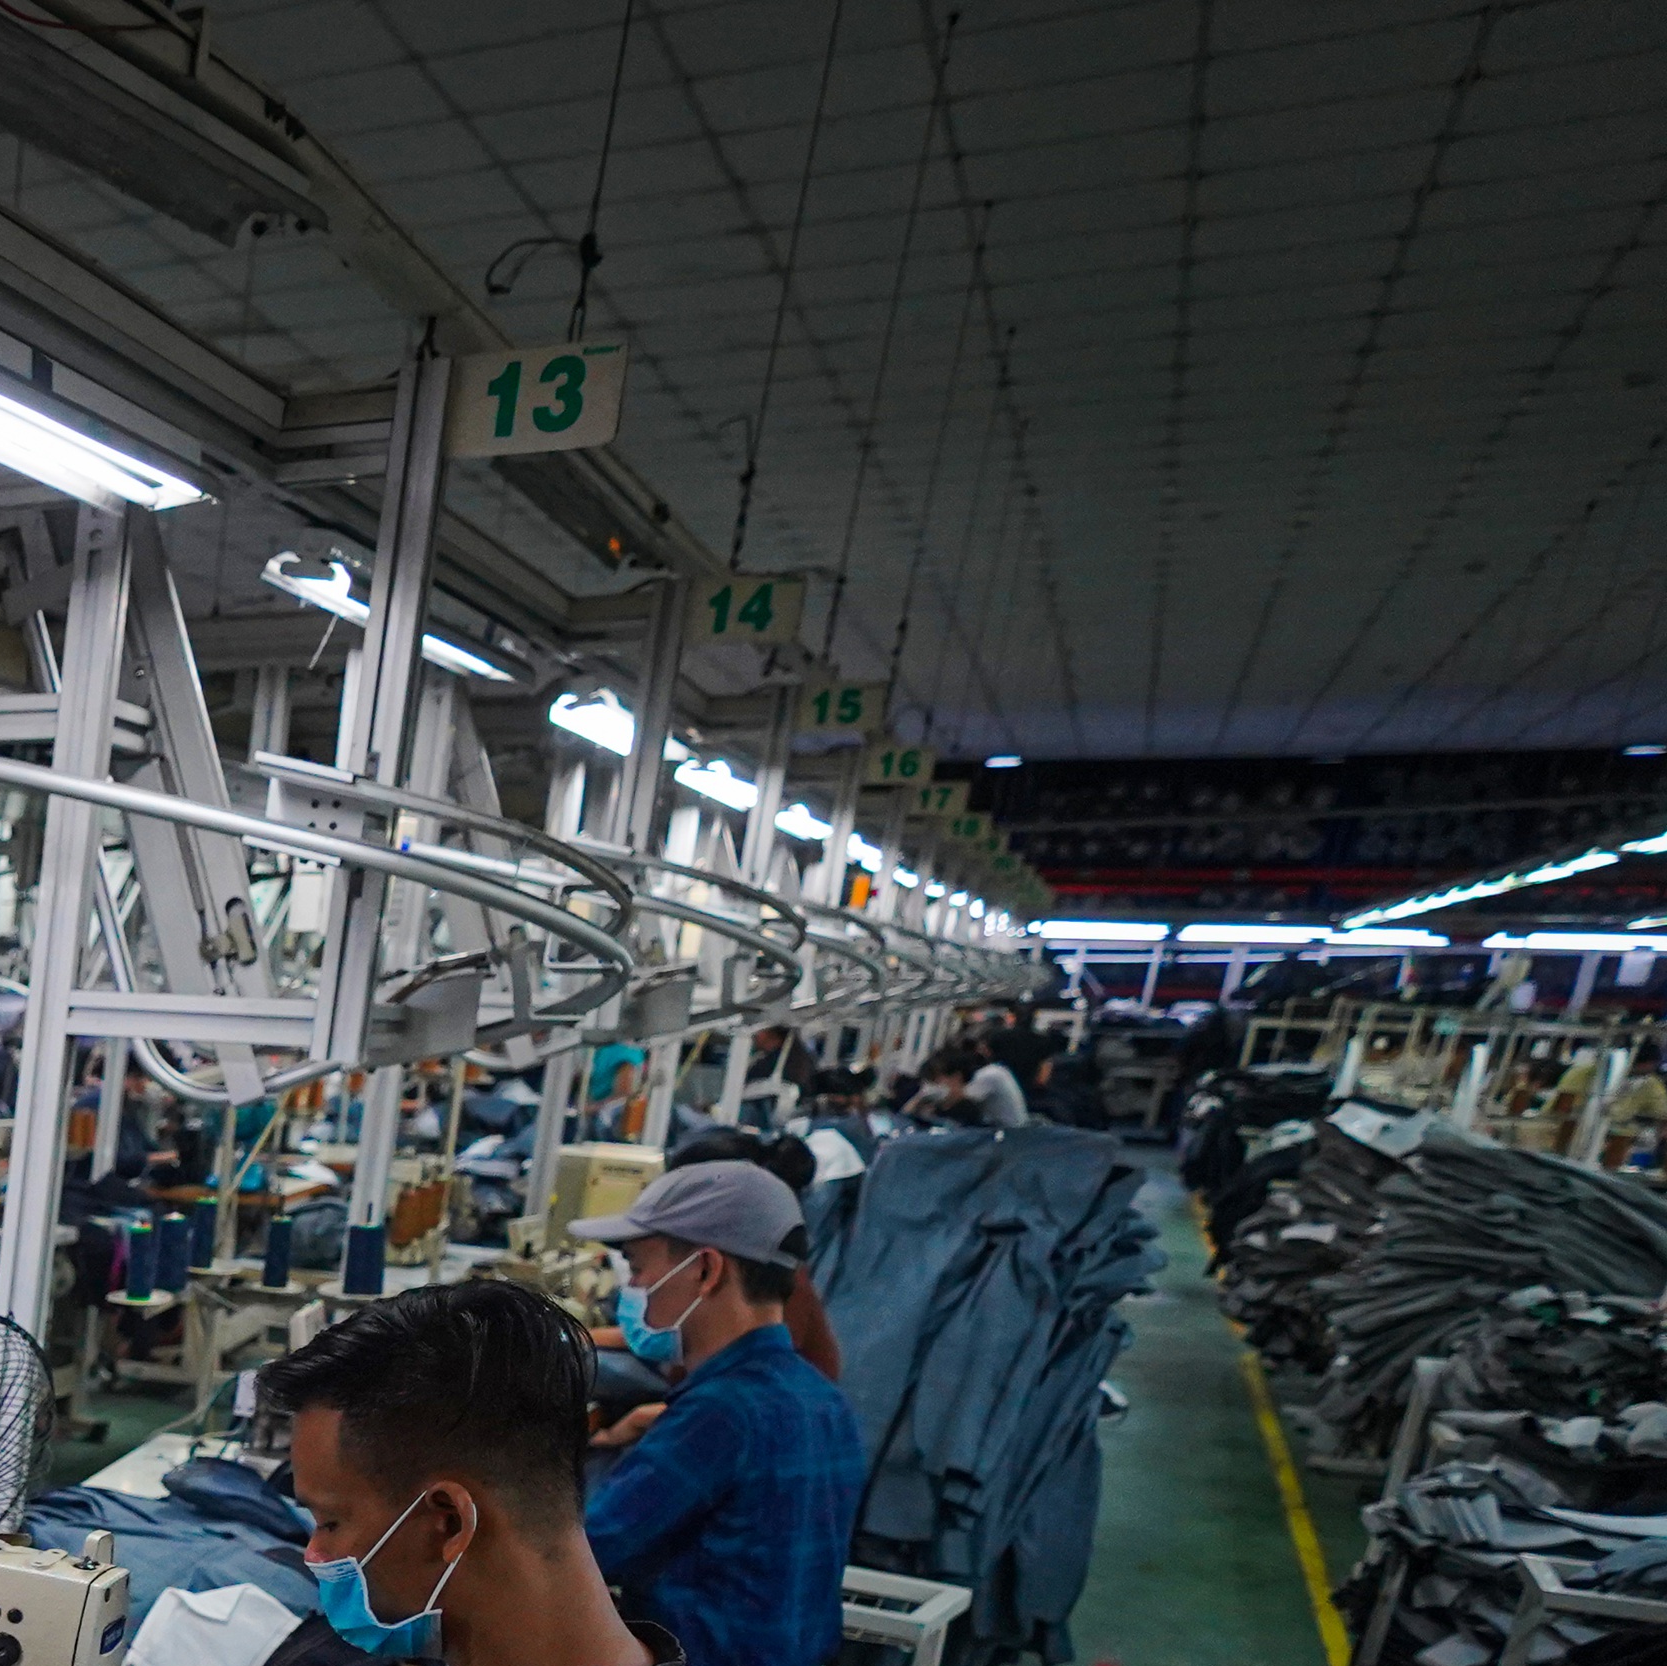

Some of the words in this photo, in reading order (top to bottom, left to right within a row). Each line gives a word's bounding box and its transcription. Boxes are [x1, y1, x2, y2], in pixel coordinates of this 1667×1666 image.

[487, 354, 586, 438] 13
[709, 582, 774, 634] 14
[813, 687, 864, 725] 15
[880, 751, 920, 778] 16
[921, 787, 953, 810] 17
